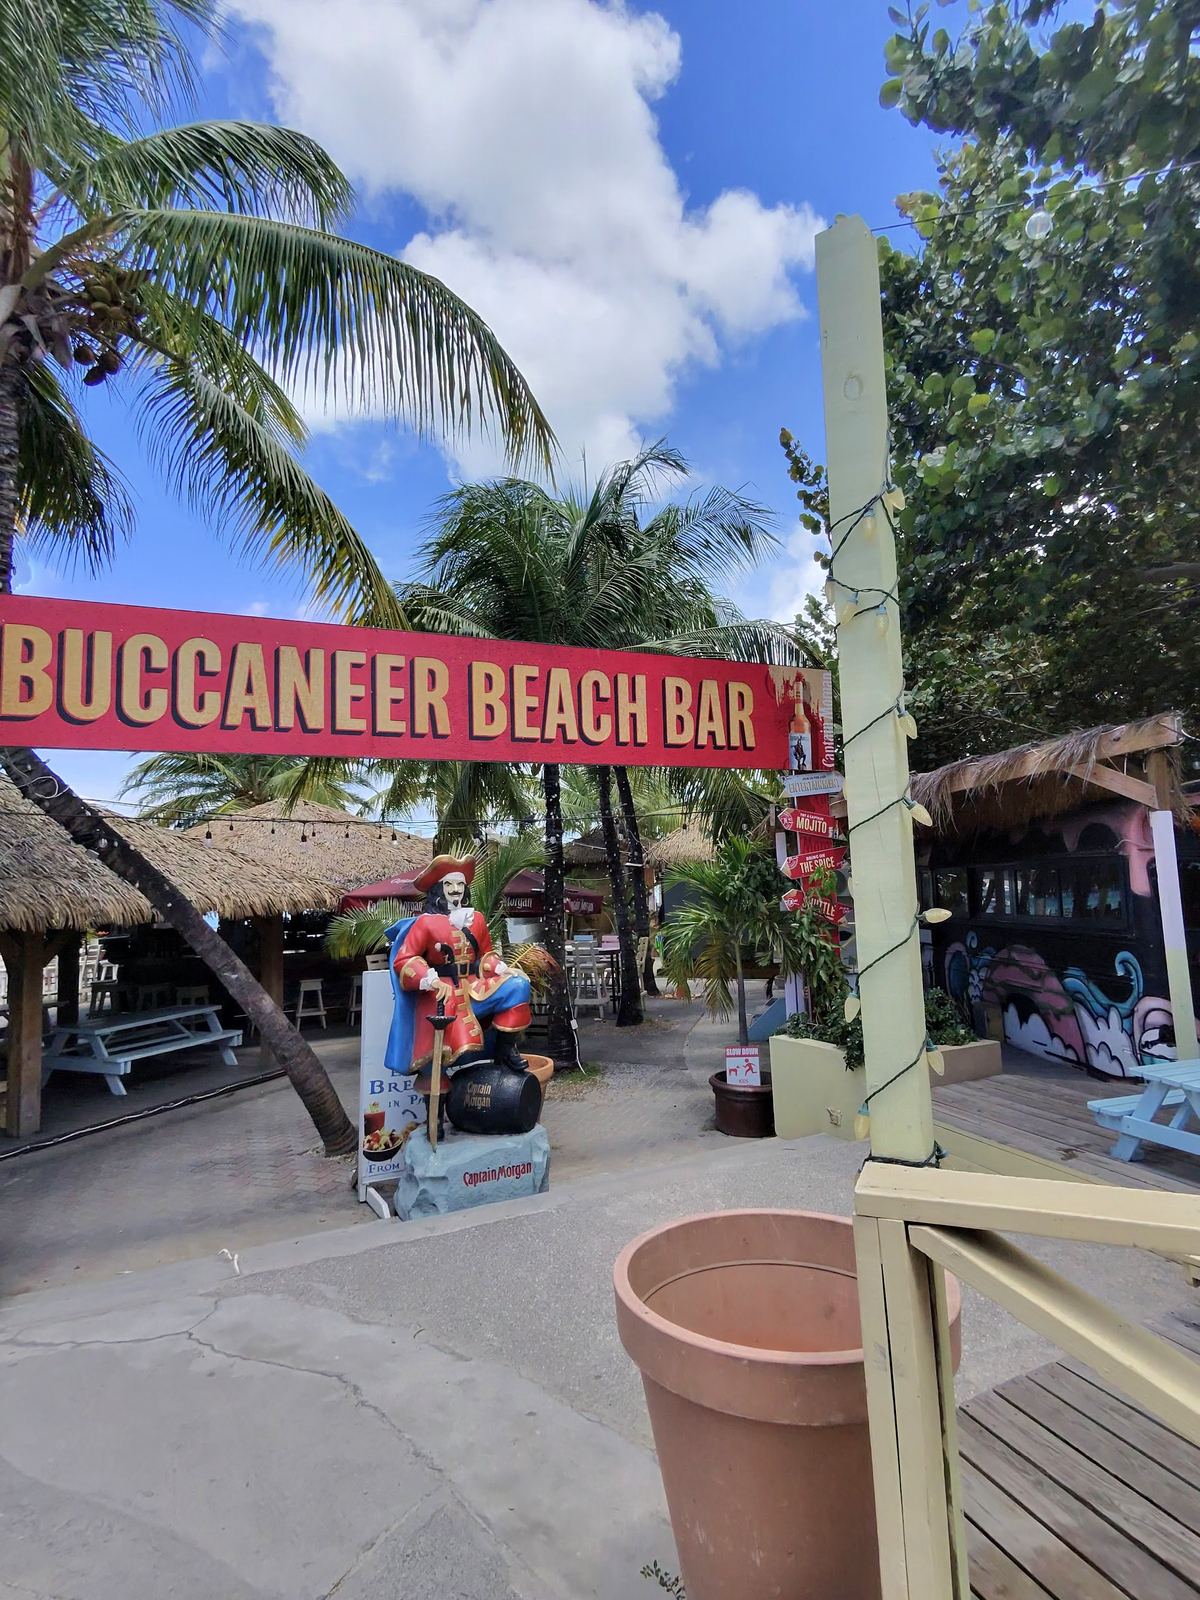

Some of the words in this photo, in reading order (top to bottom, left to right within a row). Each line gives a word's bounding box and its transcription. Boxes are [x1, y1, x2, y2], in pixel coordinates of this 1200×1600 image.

[0, 623, 452, 739] BUCCANEER
[469, 661, 648, 747] BEACH
[664, 676, 756, 750] BAR
[796, 816, 827, 834] MOJITO
[800, 860, 814, 874] THE
[814, 856, 835, 869] SPICE
[742, 1047, 759, 1055] DOWN
[467, 1081, 491, 1095] Captain
[388, 1099, 400, 1107] IN
[464, 1094, 491, 1109] Morgan
[368, 1162, 399, 1174] FROM
[463, 1167, 497, 1187] Captain
[496, 1161, 532, 1182] Morgan
